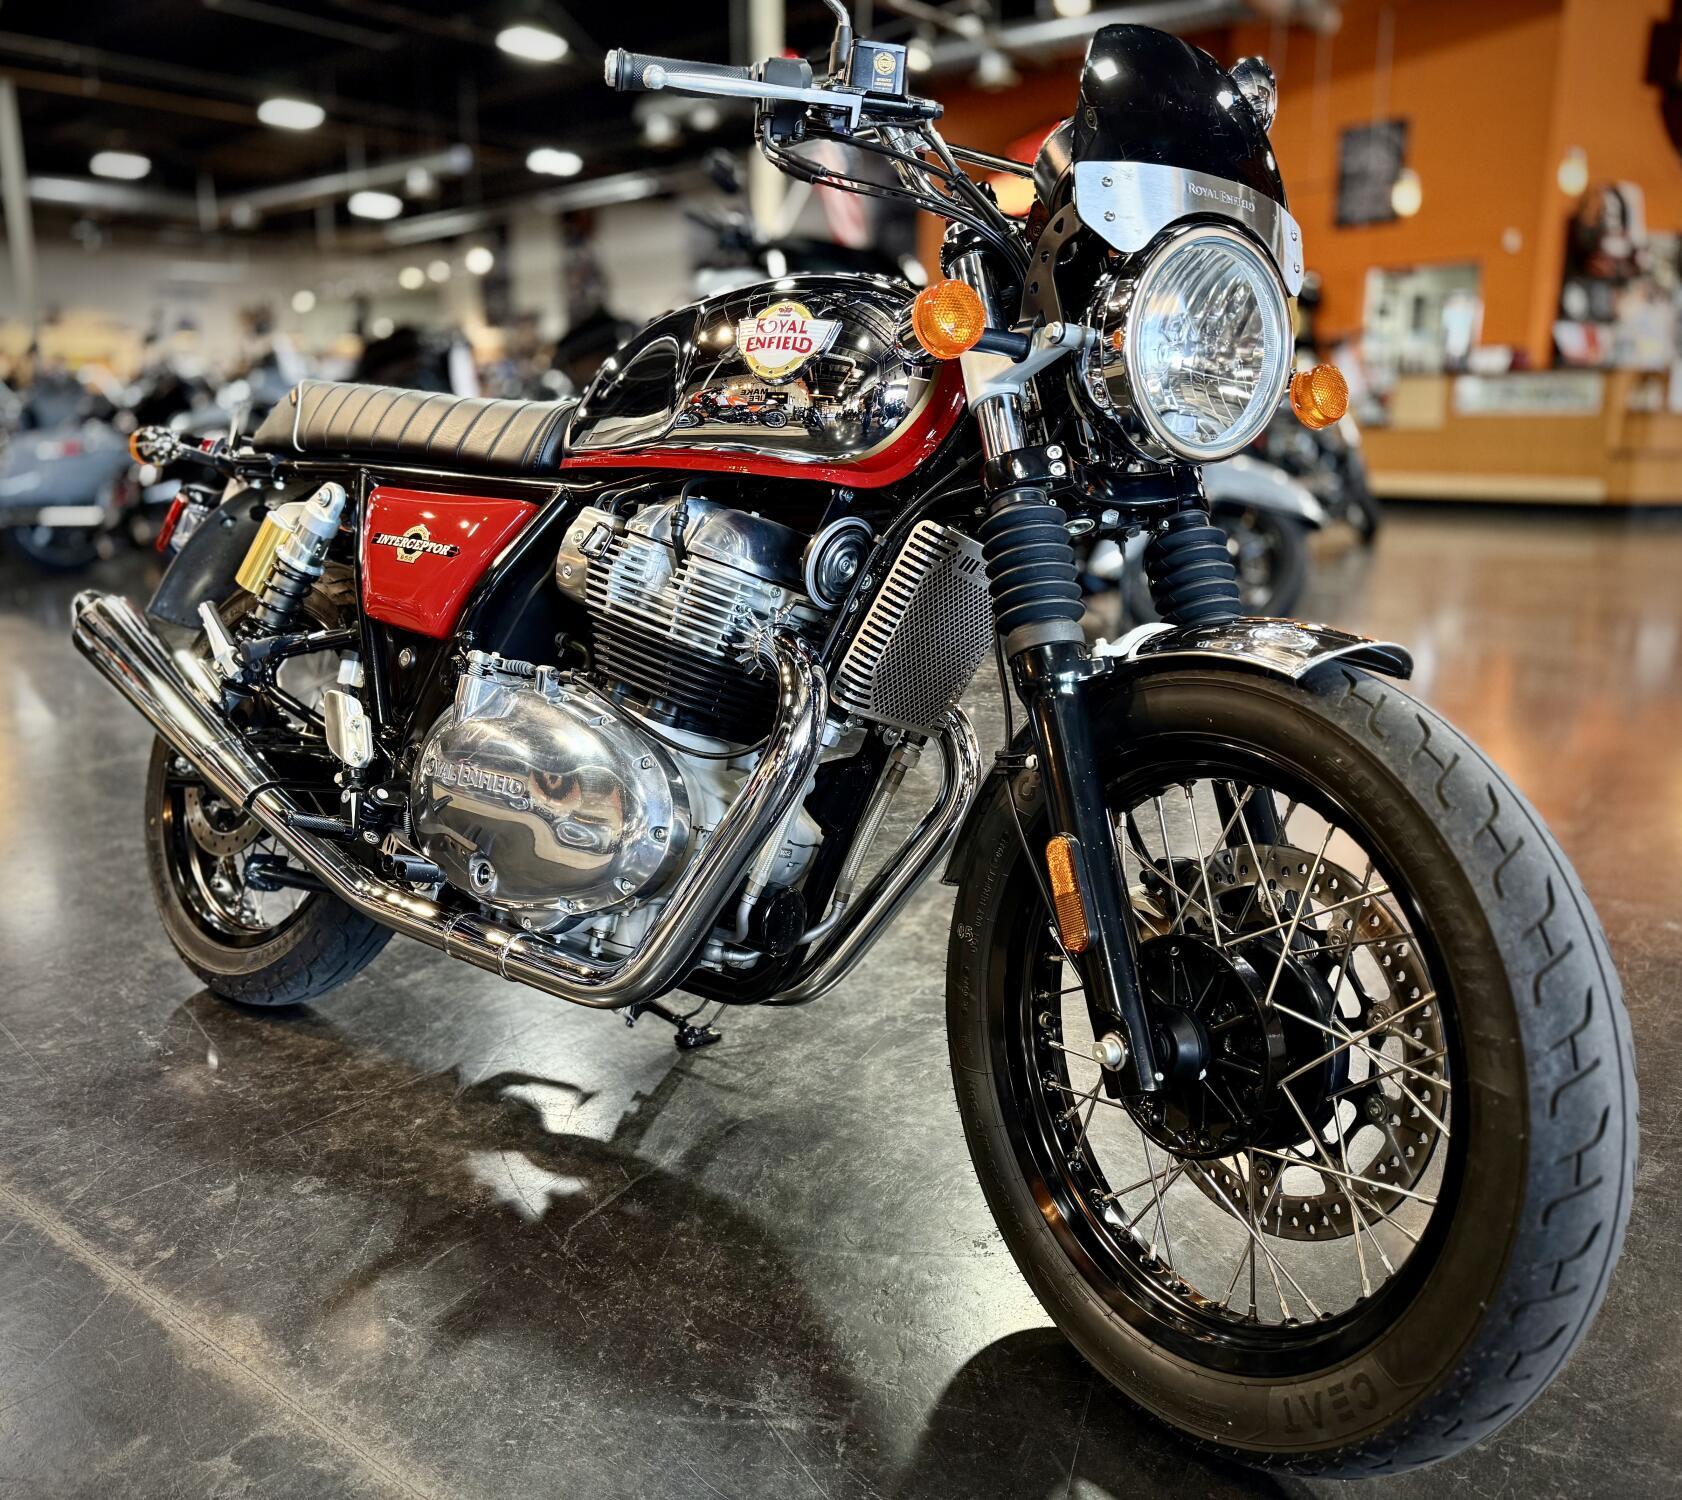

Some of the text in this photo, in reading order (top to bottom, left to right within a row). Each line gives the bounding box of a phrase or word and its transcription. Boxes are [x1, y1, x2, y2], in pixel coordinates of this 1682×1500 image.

[1187, 182, 1255, 212] ROYAL ENFIELD
[756, 318, 808, 334] ROYAL
[745, 335, 813, 354] ENFIELD
[376, 533, 452, 556] INTERCEPTOR
[457, 762, 526, 798] ENFIELD
